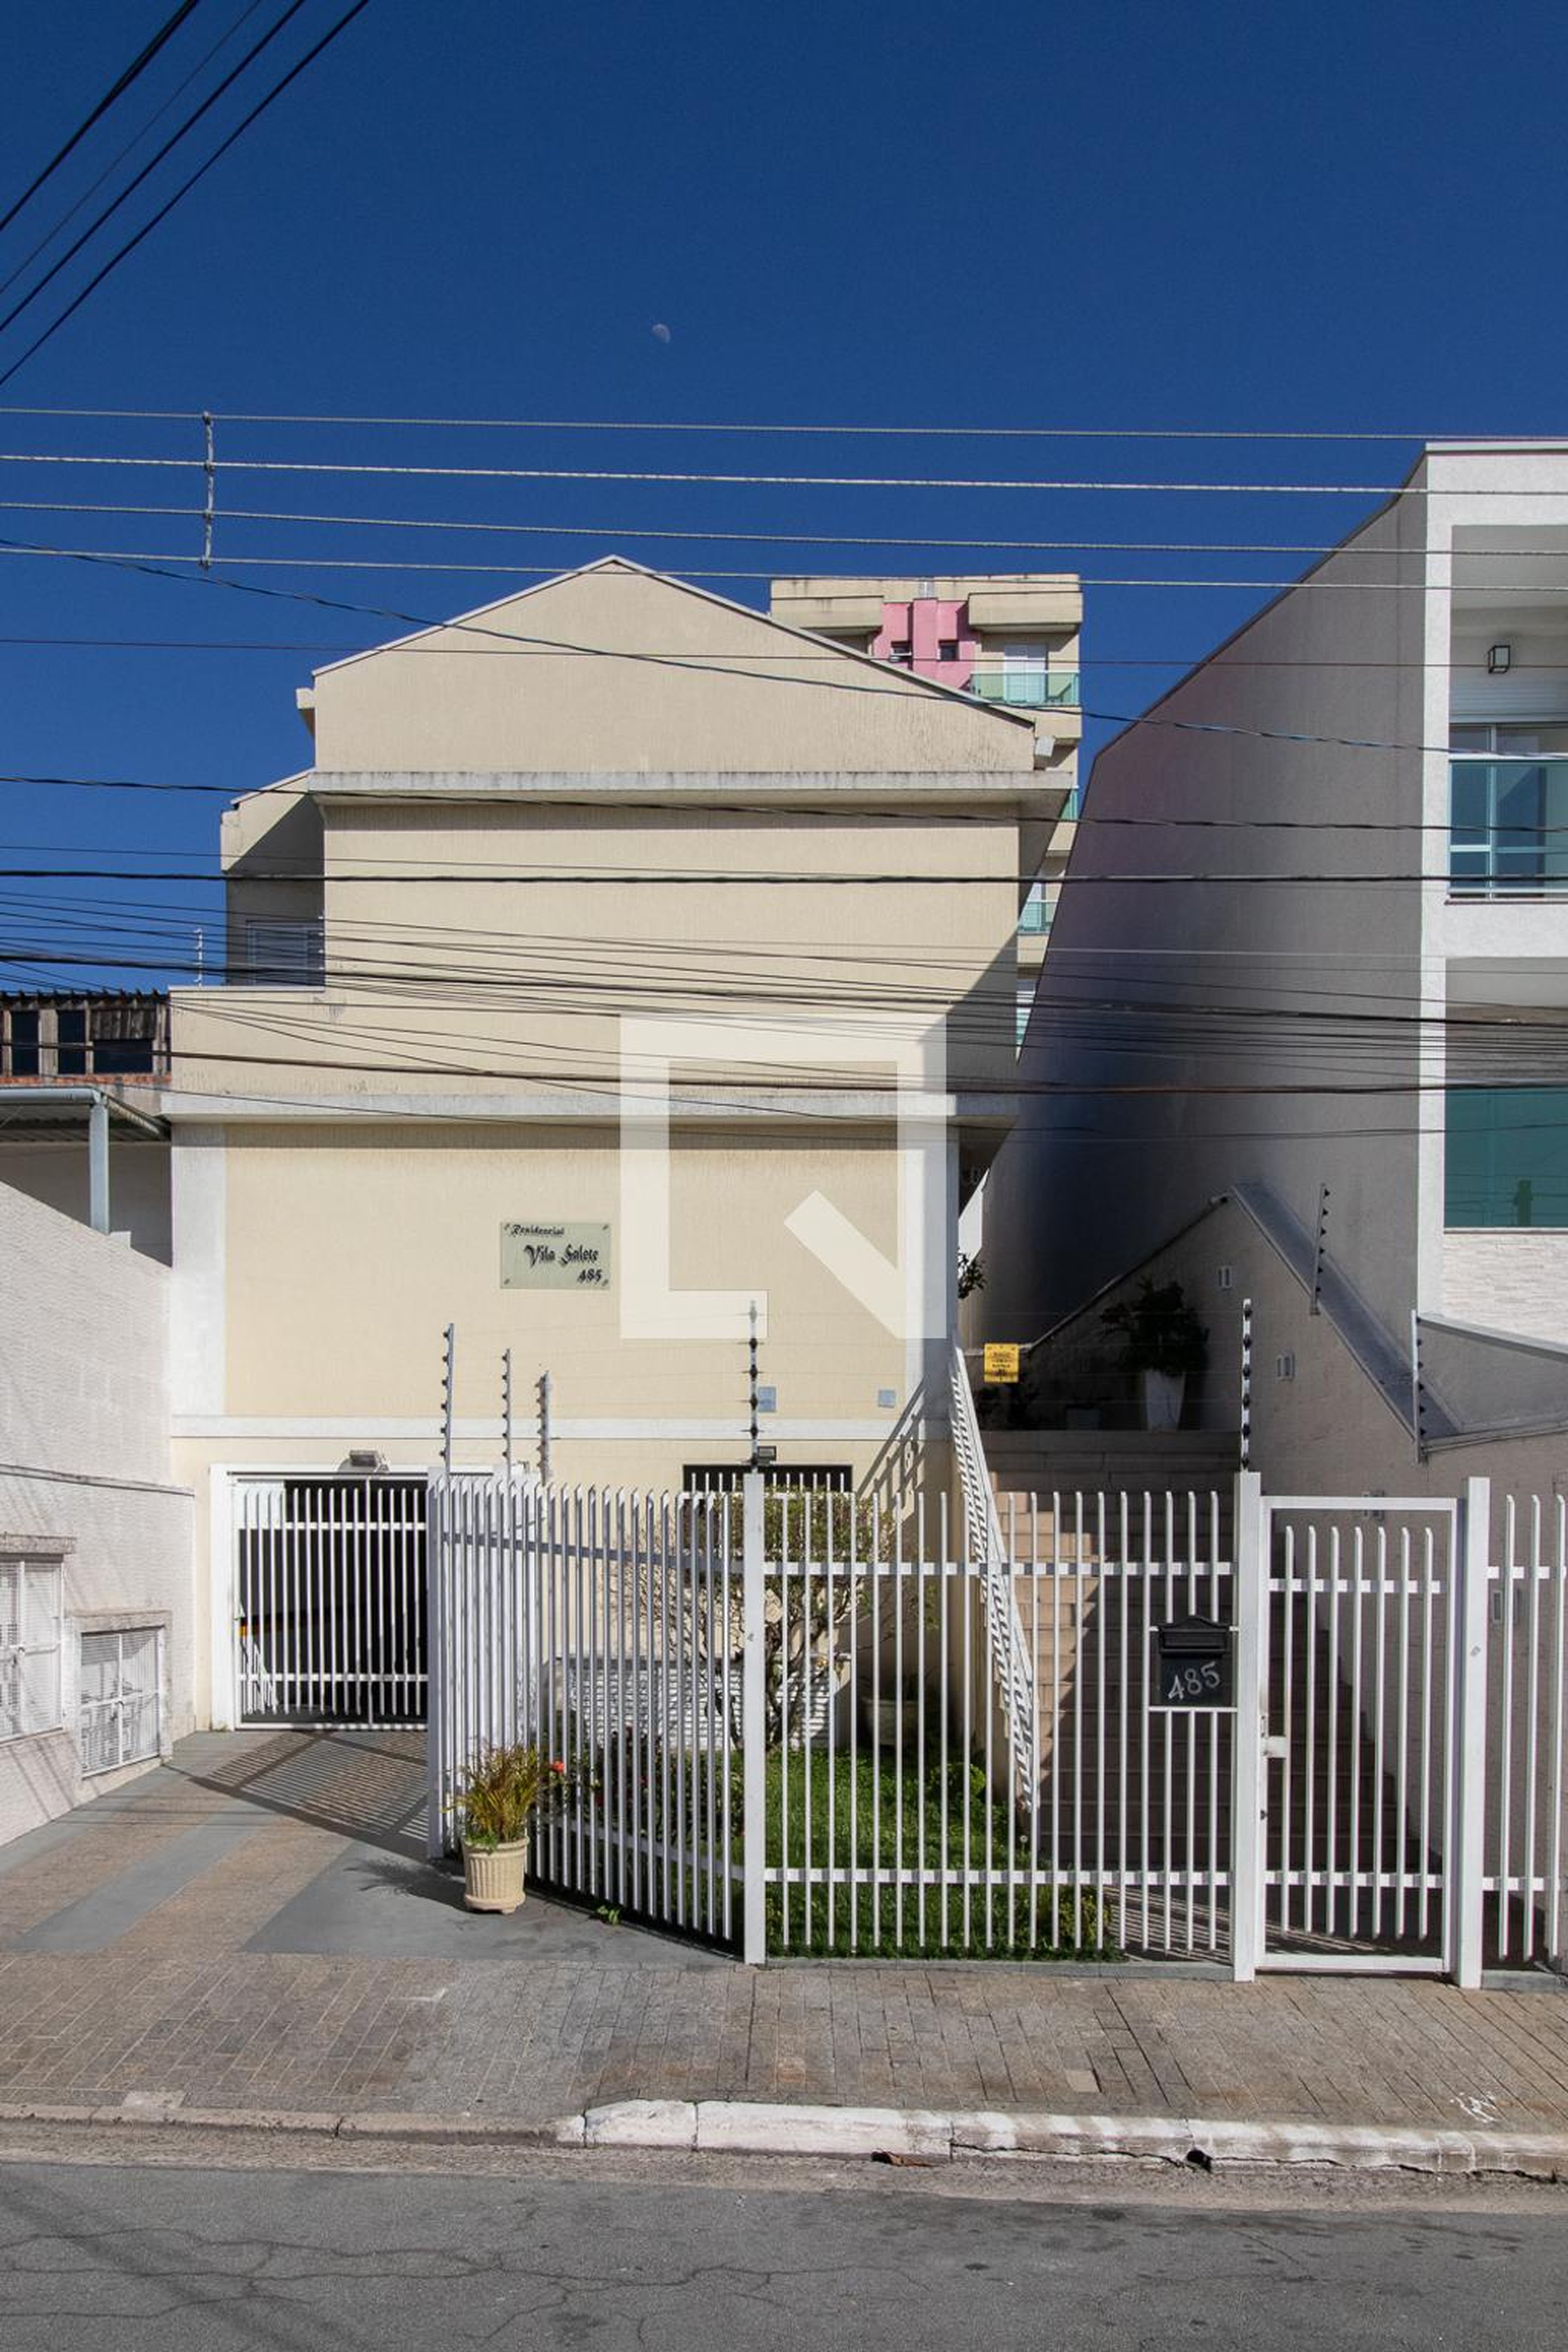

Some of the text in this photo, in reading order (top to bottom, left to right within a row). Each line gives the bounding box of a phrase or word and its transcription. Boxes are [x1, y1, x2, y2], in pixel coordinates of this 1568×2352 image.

[524, 1245, 555, 1267] Vila
[577, 1268, 602, 1283] 485
[1168, 1661, 1221, 1699] 485
